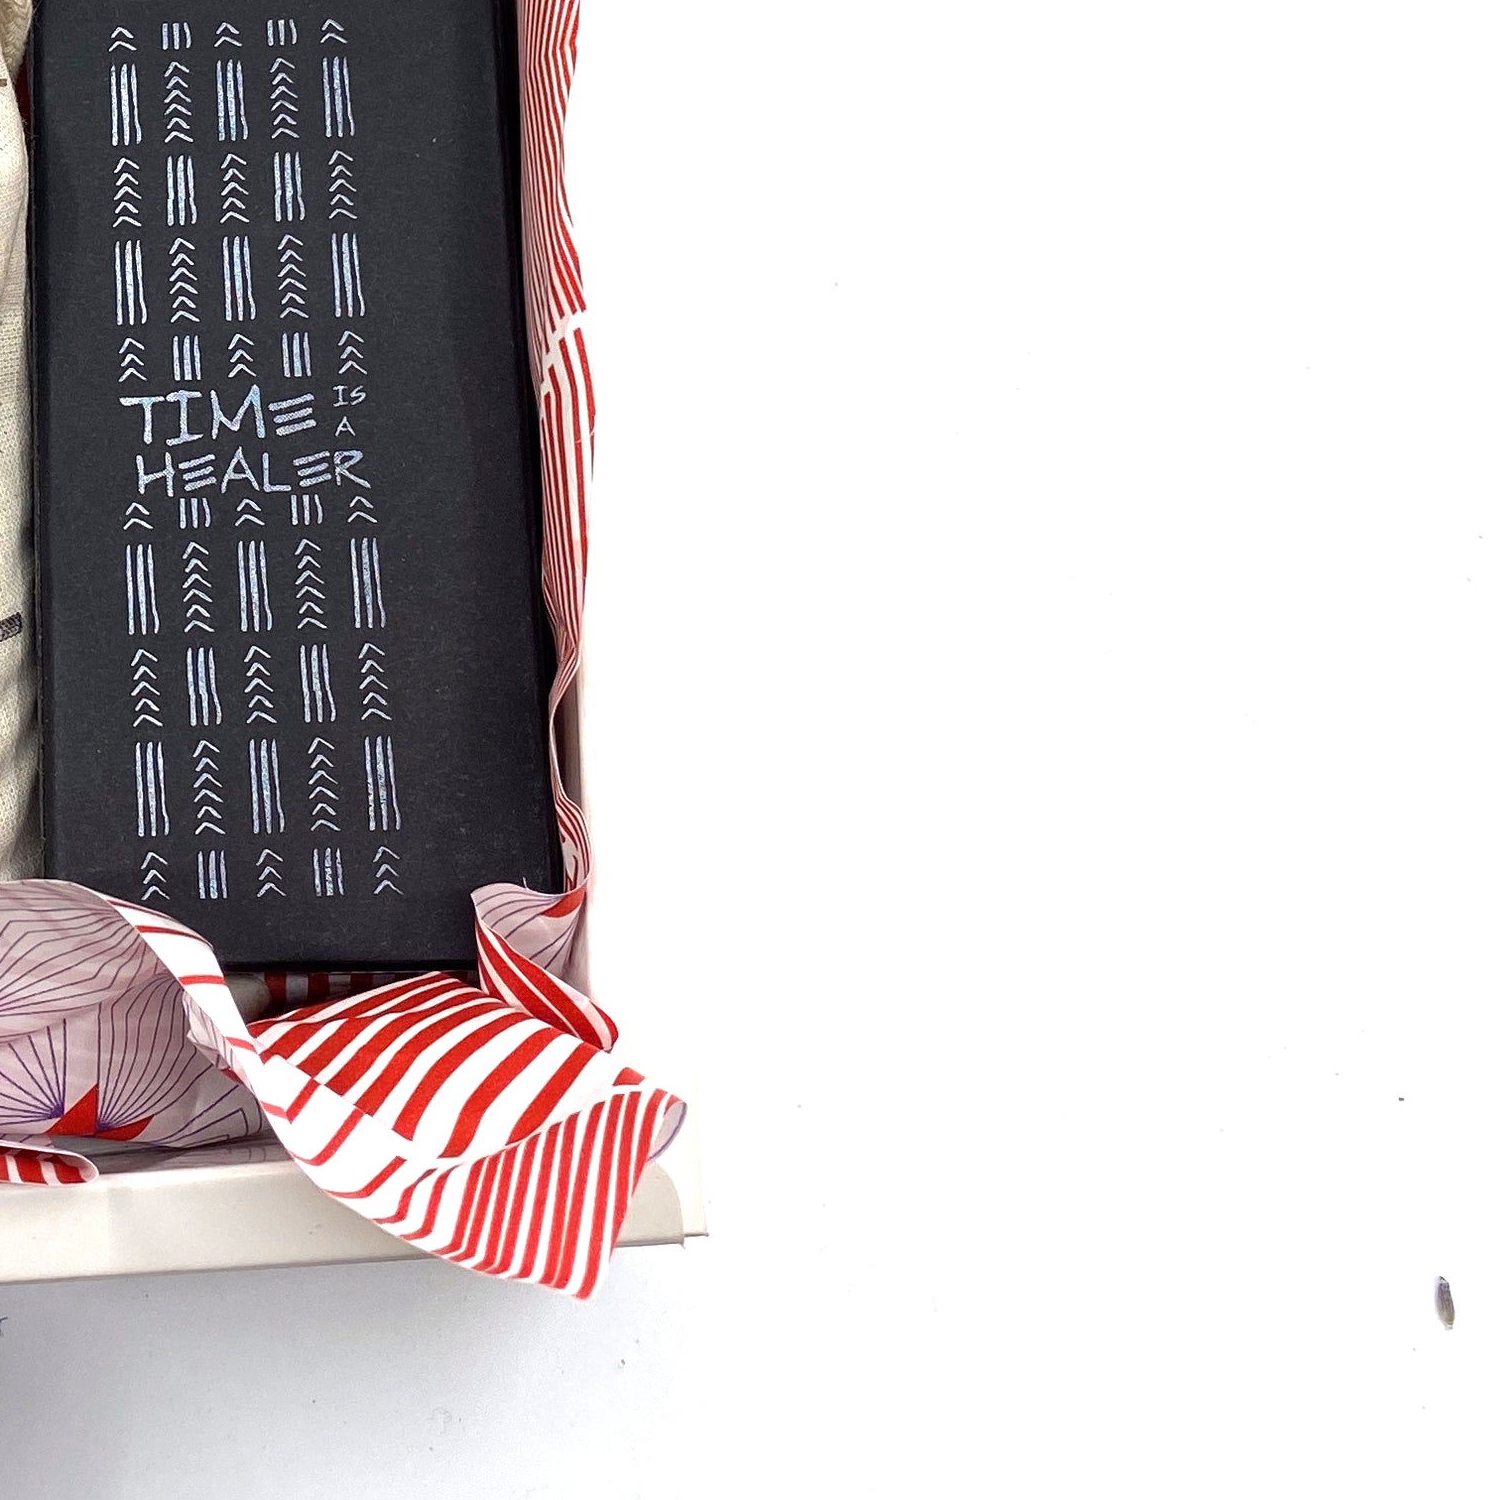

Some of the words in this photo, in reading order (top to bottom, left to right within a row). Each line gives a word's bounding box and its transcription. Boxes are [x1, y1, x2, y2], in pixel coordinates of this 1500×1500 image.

[118, 383, 317, 447] TIME
[332, 384, 367, 408] IS
[334, 415, 356, 437] A
[135, 445, 372, 498] HEALER
